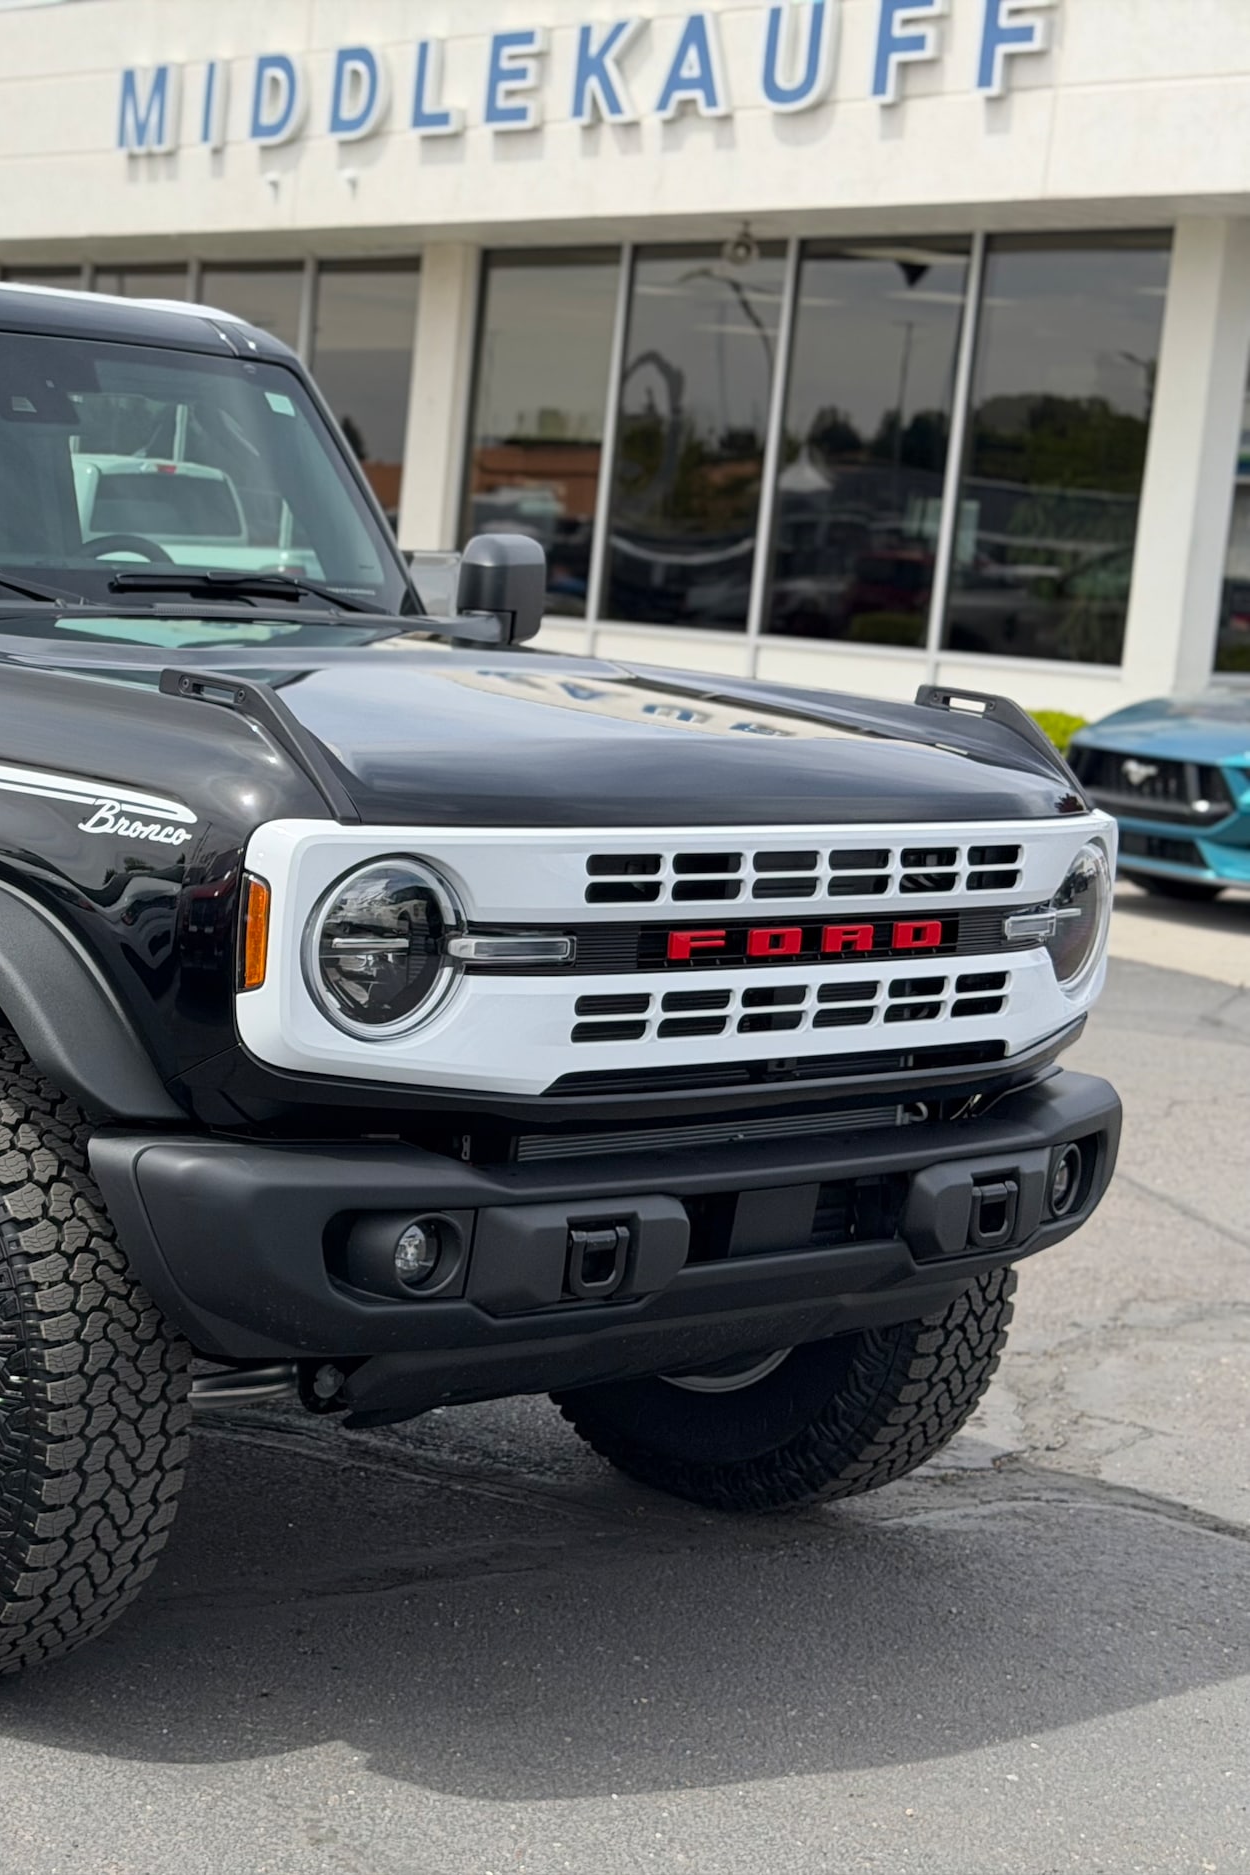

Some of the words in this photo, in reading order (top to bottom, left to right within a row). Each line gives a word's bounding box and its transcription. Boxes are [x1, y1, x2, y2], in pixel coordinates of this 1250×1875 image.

[117, 0, 1047, 153] MIDDLEKAUFF
[78, 798, 193, 846] Bronco
[666, 919, 943, 961] FORD
